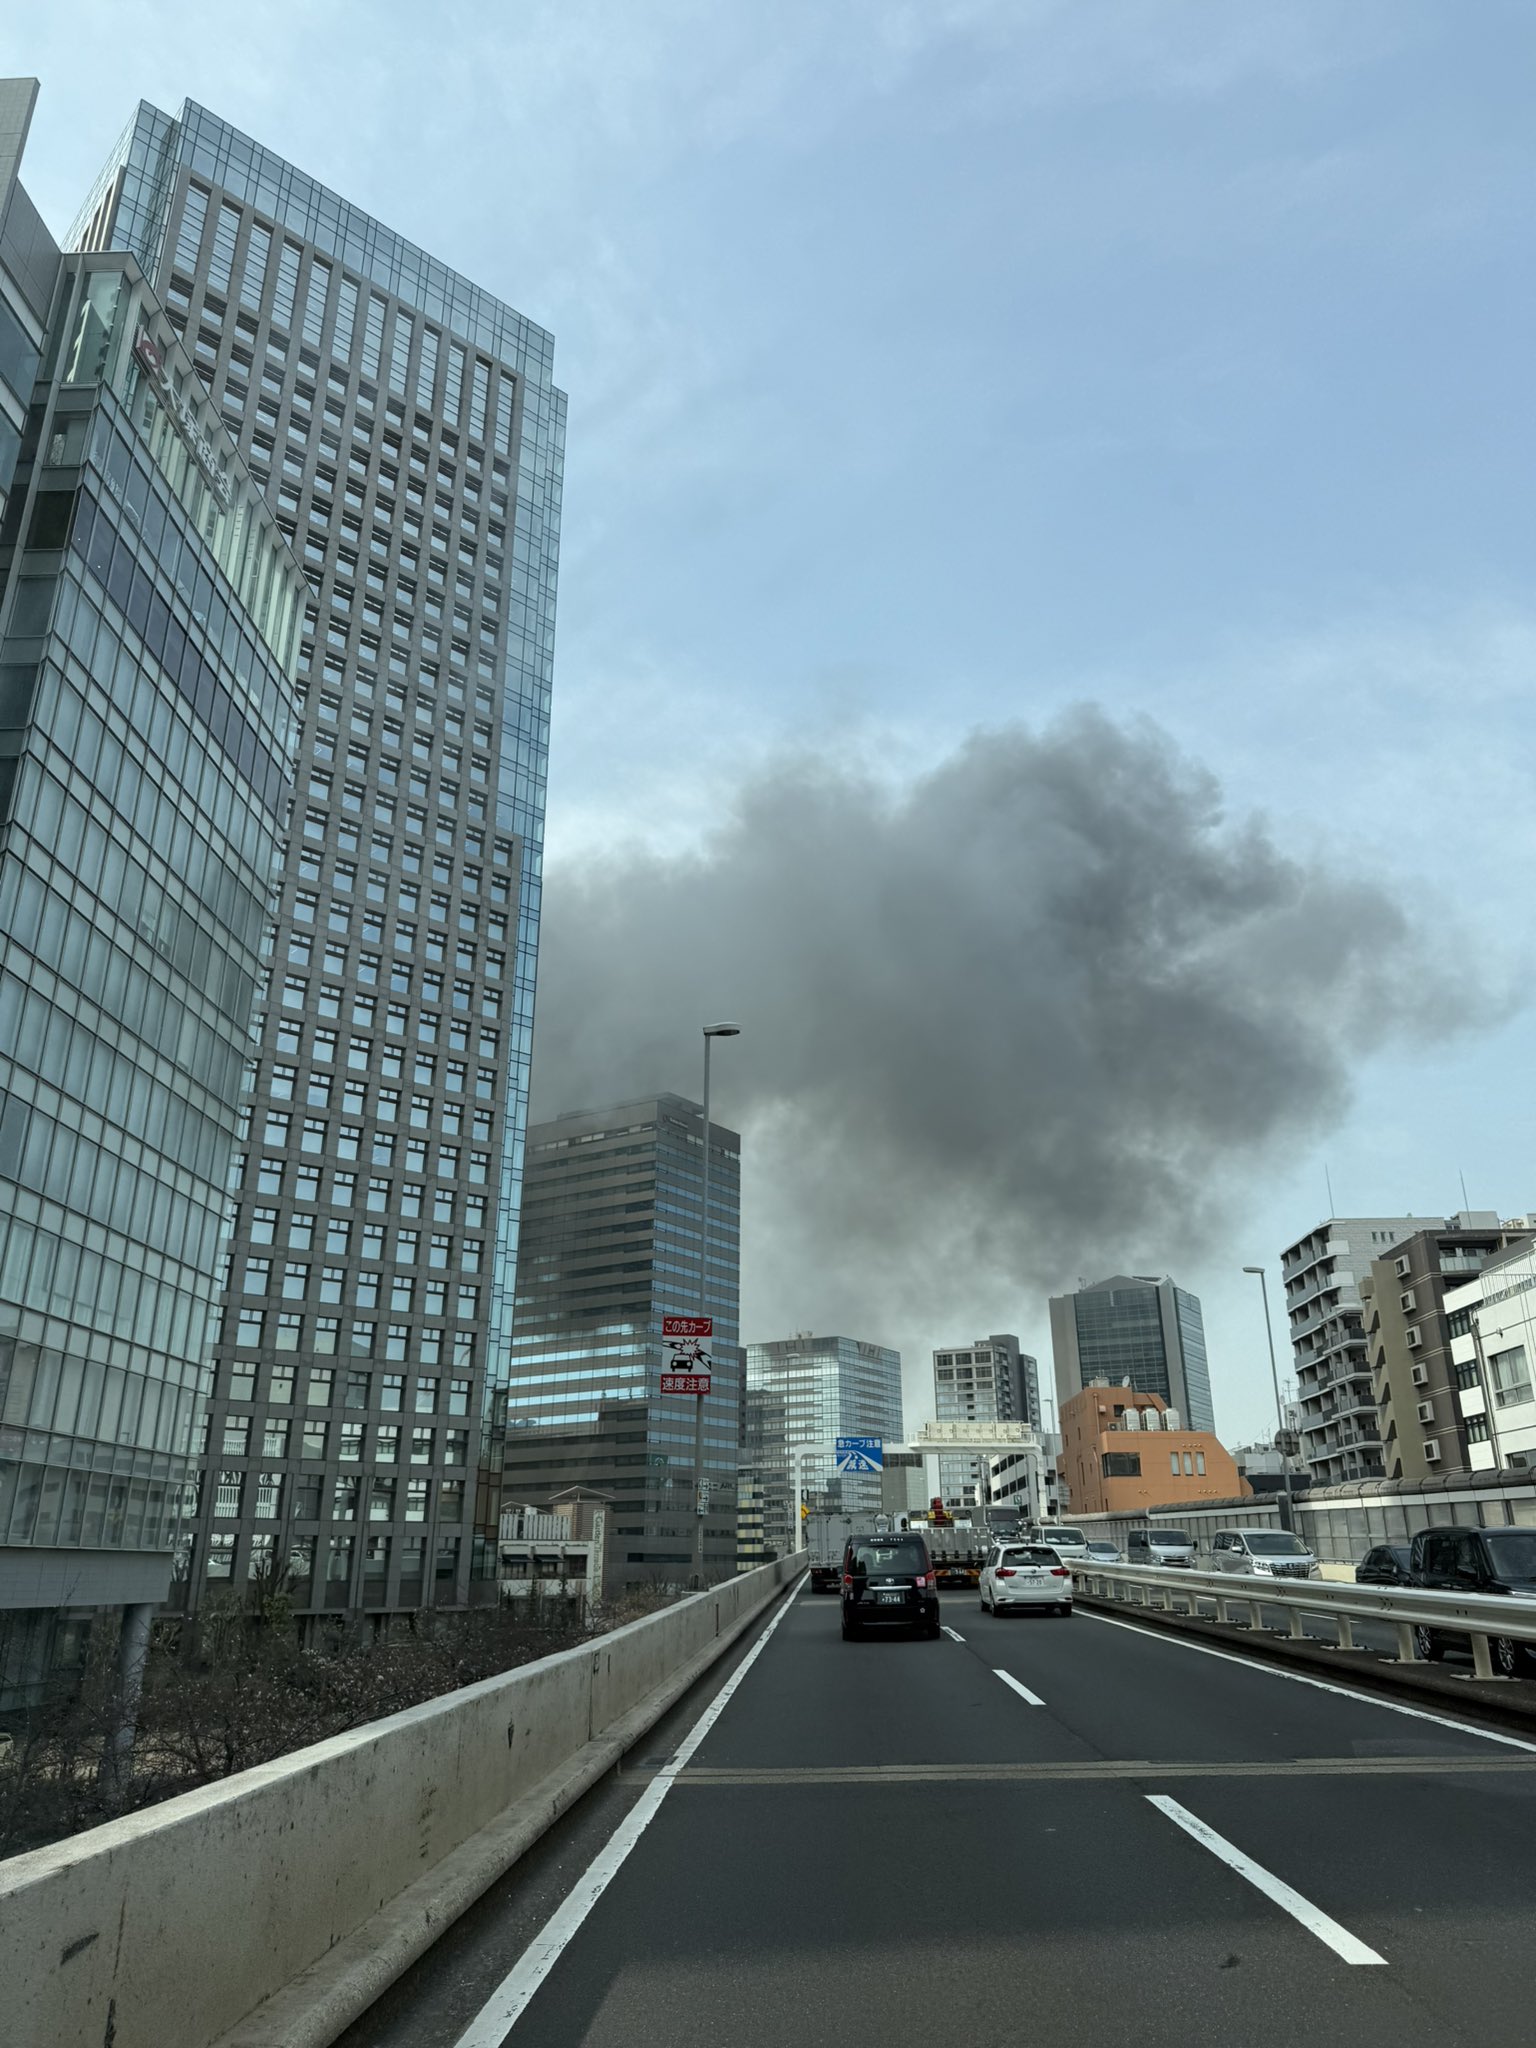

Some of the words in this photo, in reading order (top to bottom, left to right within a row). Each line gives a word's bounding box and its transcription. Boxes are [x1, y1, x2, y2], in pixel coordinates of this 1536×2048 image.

[665, 1320, 711, 1334] この先カーブ
[662, 1377, 710, 1392] 速度注意
